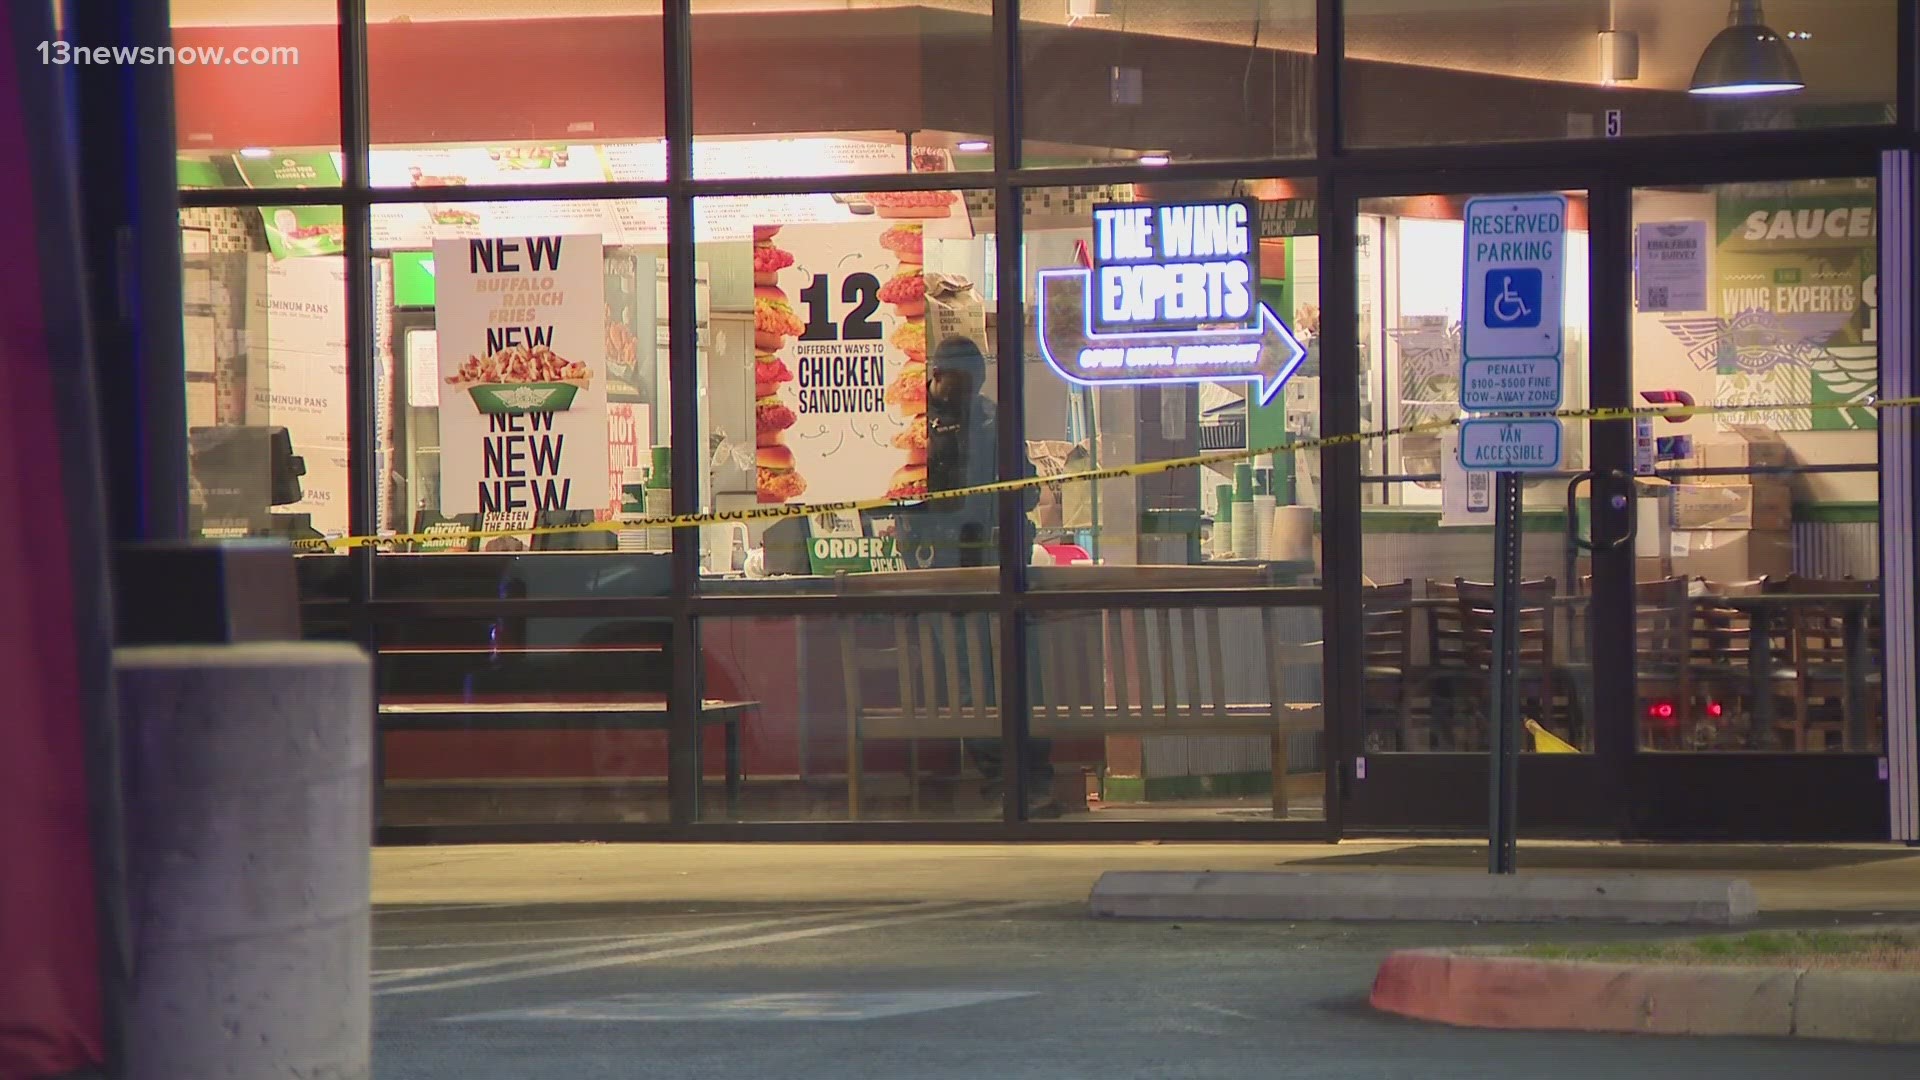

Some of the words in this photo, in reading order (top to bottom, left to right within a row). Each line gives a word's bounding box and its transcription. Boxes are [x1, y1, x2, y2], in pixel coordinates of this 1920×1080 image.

[1608, 111, 1618, 136] 5
[1258, 202, 1286, 220] INE
[1095, 208, 1154, 260] THE
[1160, 203, 1249, 257] WING
[1472, 213, 1560, 235] RESERVED
[1744, 207, 1877, 241] SAUCE
[470, 236, 562, 273] NEW
[1477, 240, 1552, 262] PARKING
[475, 277, 555, 292] BUFFALO
[1100, 260, 1250, 322] EXPERTS
[255, 298, 303, 312] ALUMINUM
[304, 301, 328, 314] PANS
[502, 292, 564, 308] RANCH
[798, 272, 882, 341] 12
[1722, 286, 1770, 314] WING
[1776, 285, 1855, 313] EXPERTS
[488, 308, 536, 323] FRIES
[486, 325, 554, 357] NEW
[797, 345, 842, 355] DIFFERENT
[844, 344, 870, 354] WAYS
[873, 344, 884, 353] TO
[799, 356, 884, 388] CHICKEN
[1487, 364, 1535, 375] PENALTY
[1528, 376, 1552, 388] FINE
[254, 392, 302, 407] ALUMINUM
[303, 396, 328, 409] PANS
[799, 387, 885, 414] SANDWICH
[1466, 391, 1525, 403] TOW-AWAY
[1528, 390, 1556, 401] ZONE
[489, 412, 554, 432] NEW
[610, 416, 634, 443] HOT
[1499, 428, 1522, 443] VAN
[483, 434, 564, 478] NEW
[610, 445, 634, 471] HONEY
[1475, 444, 1544, 461] ACCESSIBLE
[307, 489, 331, 501] PANS
[478, 478, 571, 514] NEW
[484, 521, 502, 532] THE
[485, 511, 530, 522] SWEETEN
[421, 536, 468, 548] SANDWICH
[813, 539, 883, 560] ORDER
